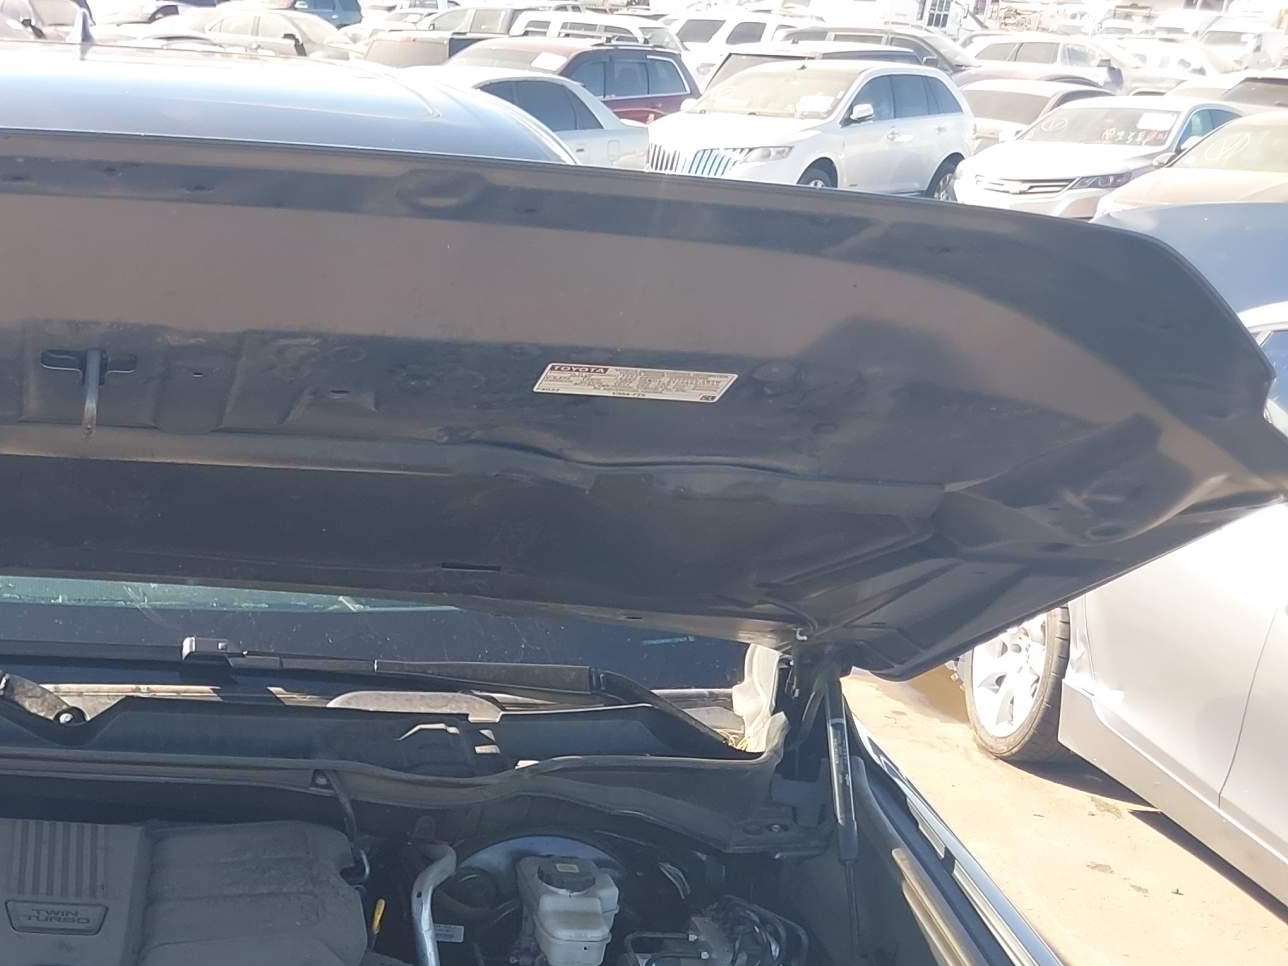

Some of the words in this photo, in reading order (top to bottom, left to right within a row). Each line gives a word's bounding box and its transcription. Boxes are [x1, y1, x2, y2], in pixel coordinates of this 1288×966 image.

[553, 365, 605, 373] TOYOTA
[31, 908, 79, 917] TWIN
[27, 914, 90, 924] TURBO
